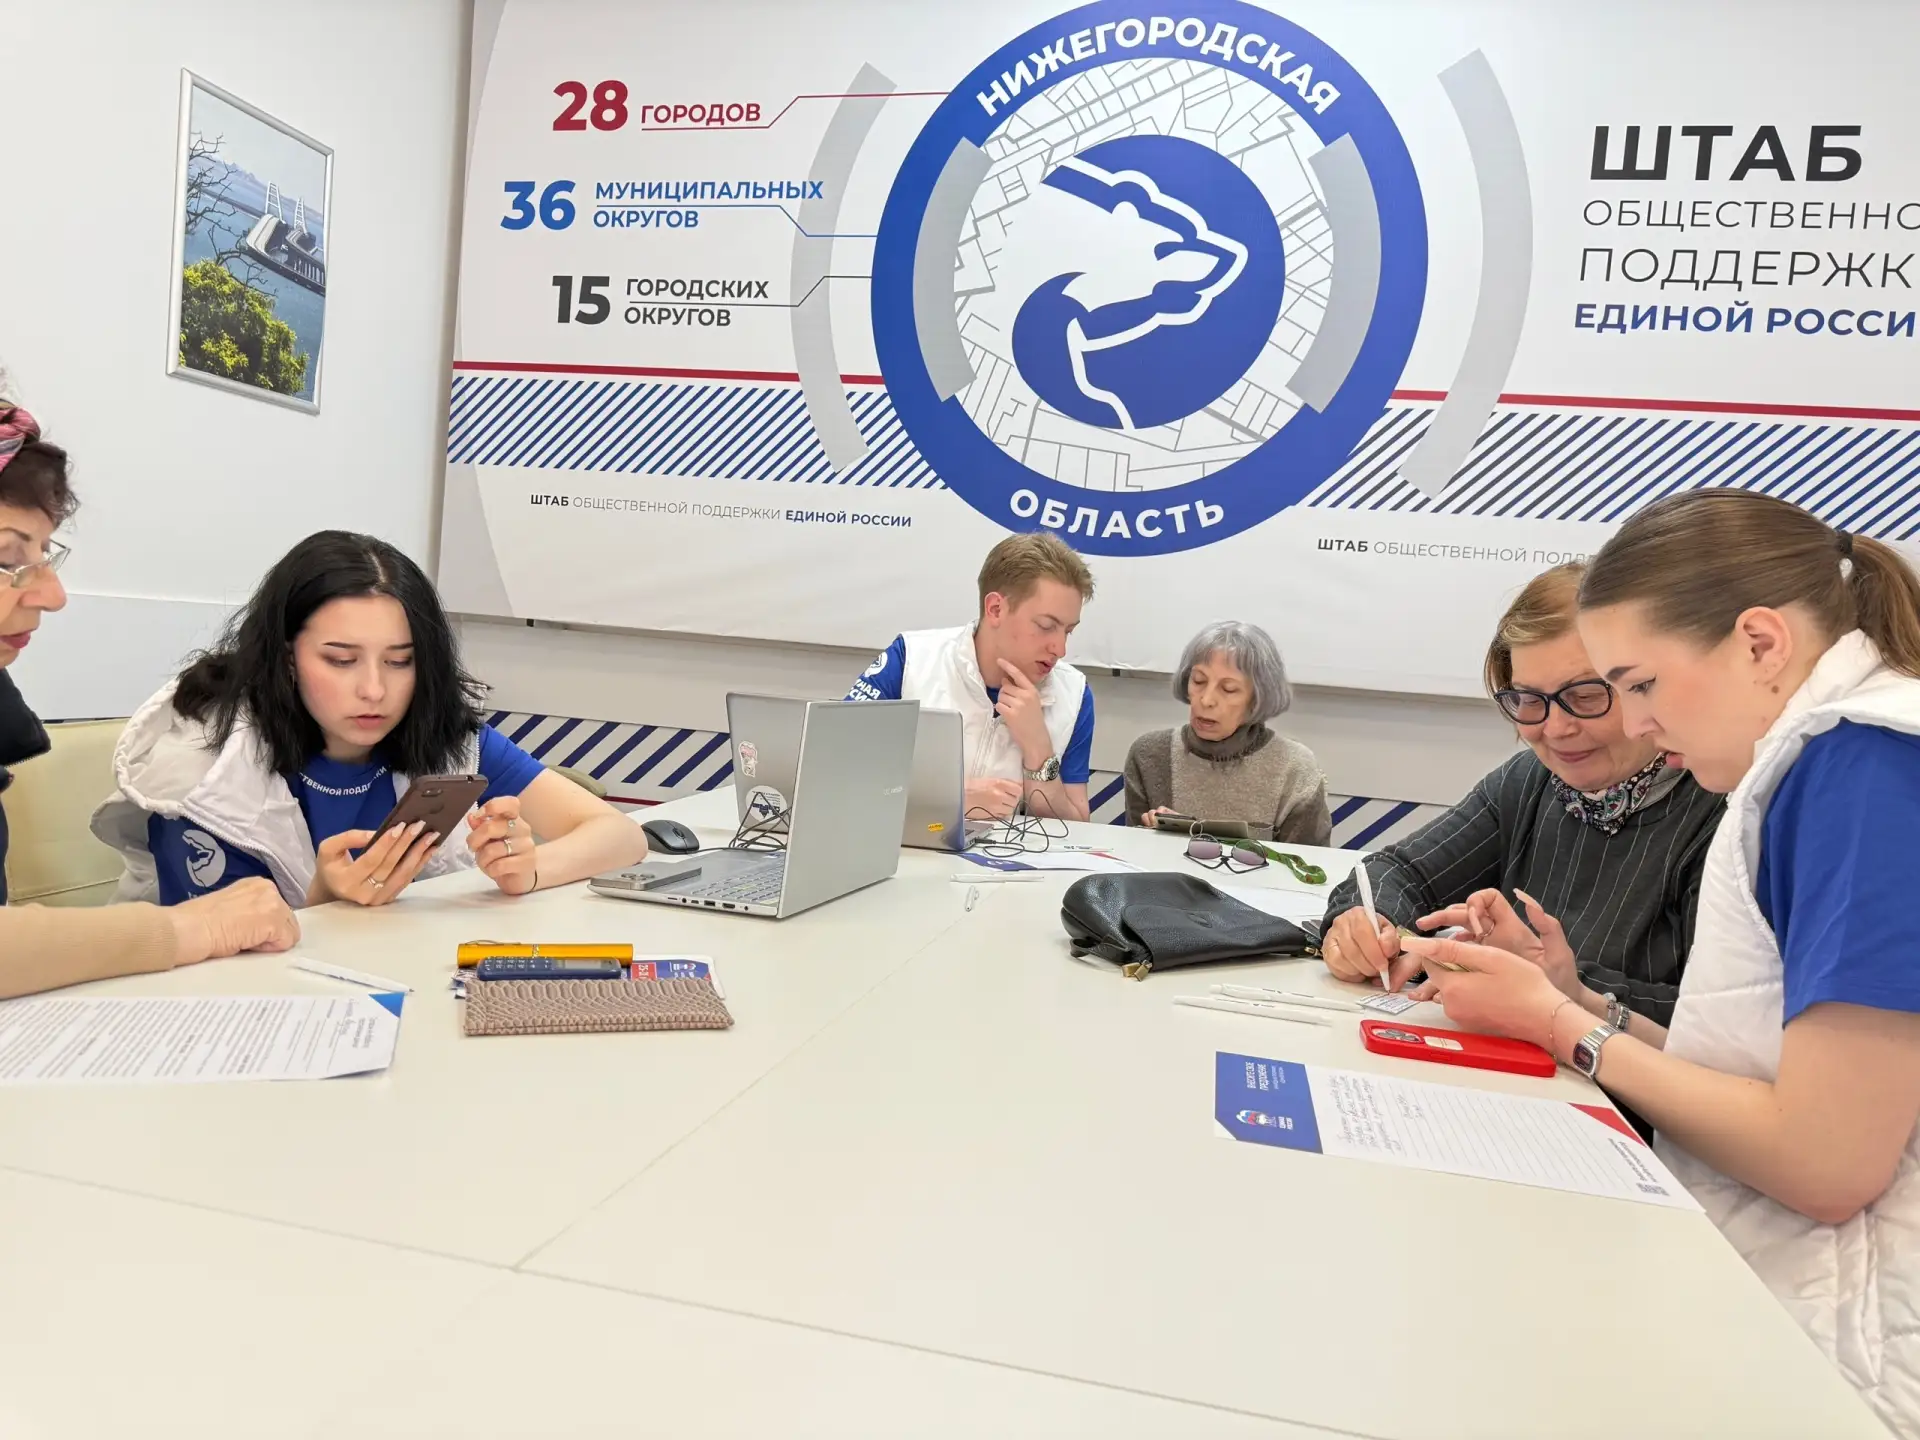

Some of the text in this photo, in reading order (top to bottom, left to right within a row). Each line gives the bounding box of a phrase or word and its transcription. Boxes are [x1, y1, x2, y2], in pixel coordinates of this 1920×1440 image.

[976, 16, 1341, 117] НИЖЕГОРОДСКАЯ
[552, 80, 761, 131] 28 ГОРОДОВ
[1590, 125, 1862, 181] ШТАБ
[500, 180, 824, 230] 36 МУНИЦИПАЛЬНЫХ
[593, 210, 699, 229] ОКРУГОВ
[1580, 247, 1915, 292] ПОДДЕРЖК
[551, 275, 769, 325] 15 ГОРОДСКИХ
[624, 306, 732, 327] ОКРУГОВ
[1574, 300, 1916, 338] ЕДИНОЙ РОССИ
[530, 494, 912, 527] ШТАБ ОБЩЕСТВЕННОЙ ПОДДЕРЖКИ ЕДИНОЙ РОССИИ
[1009, 488, 1225, 539] ОБЛАСТЬ
[1317, 538, 1598, 566] ШТАБ ОБЩЕСТВЕННОЙ ПОДД
